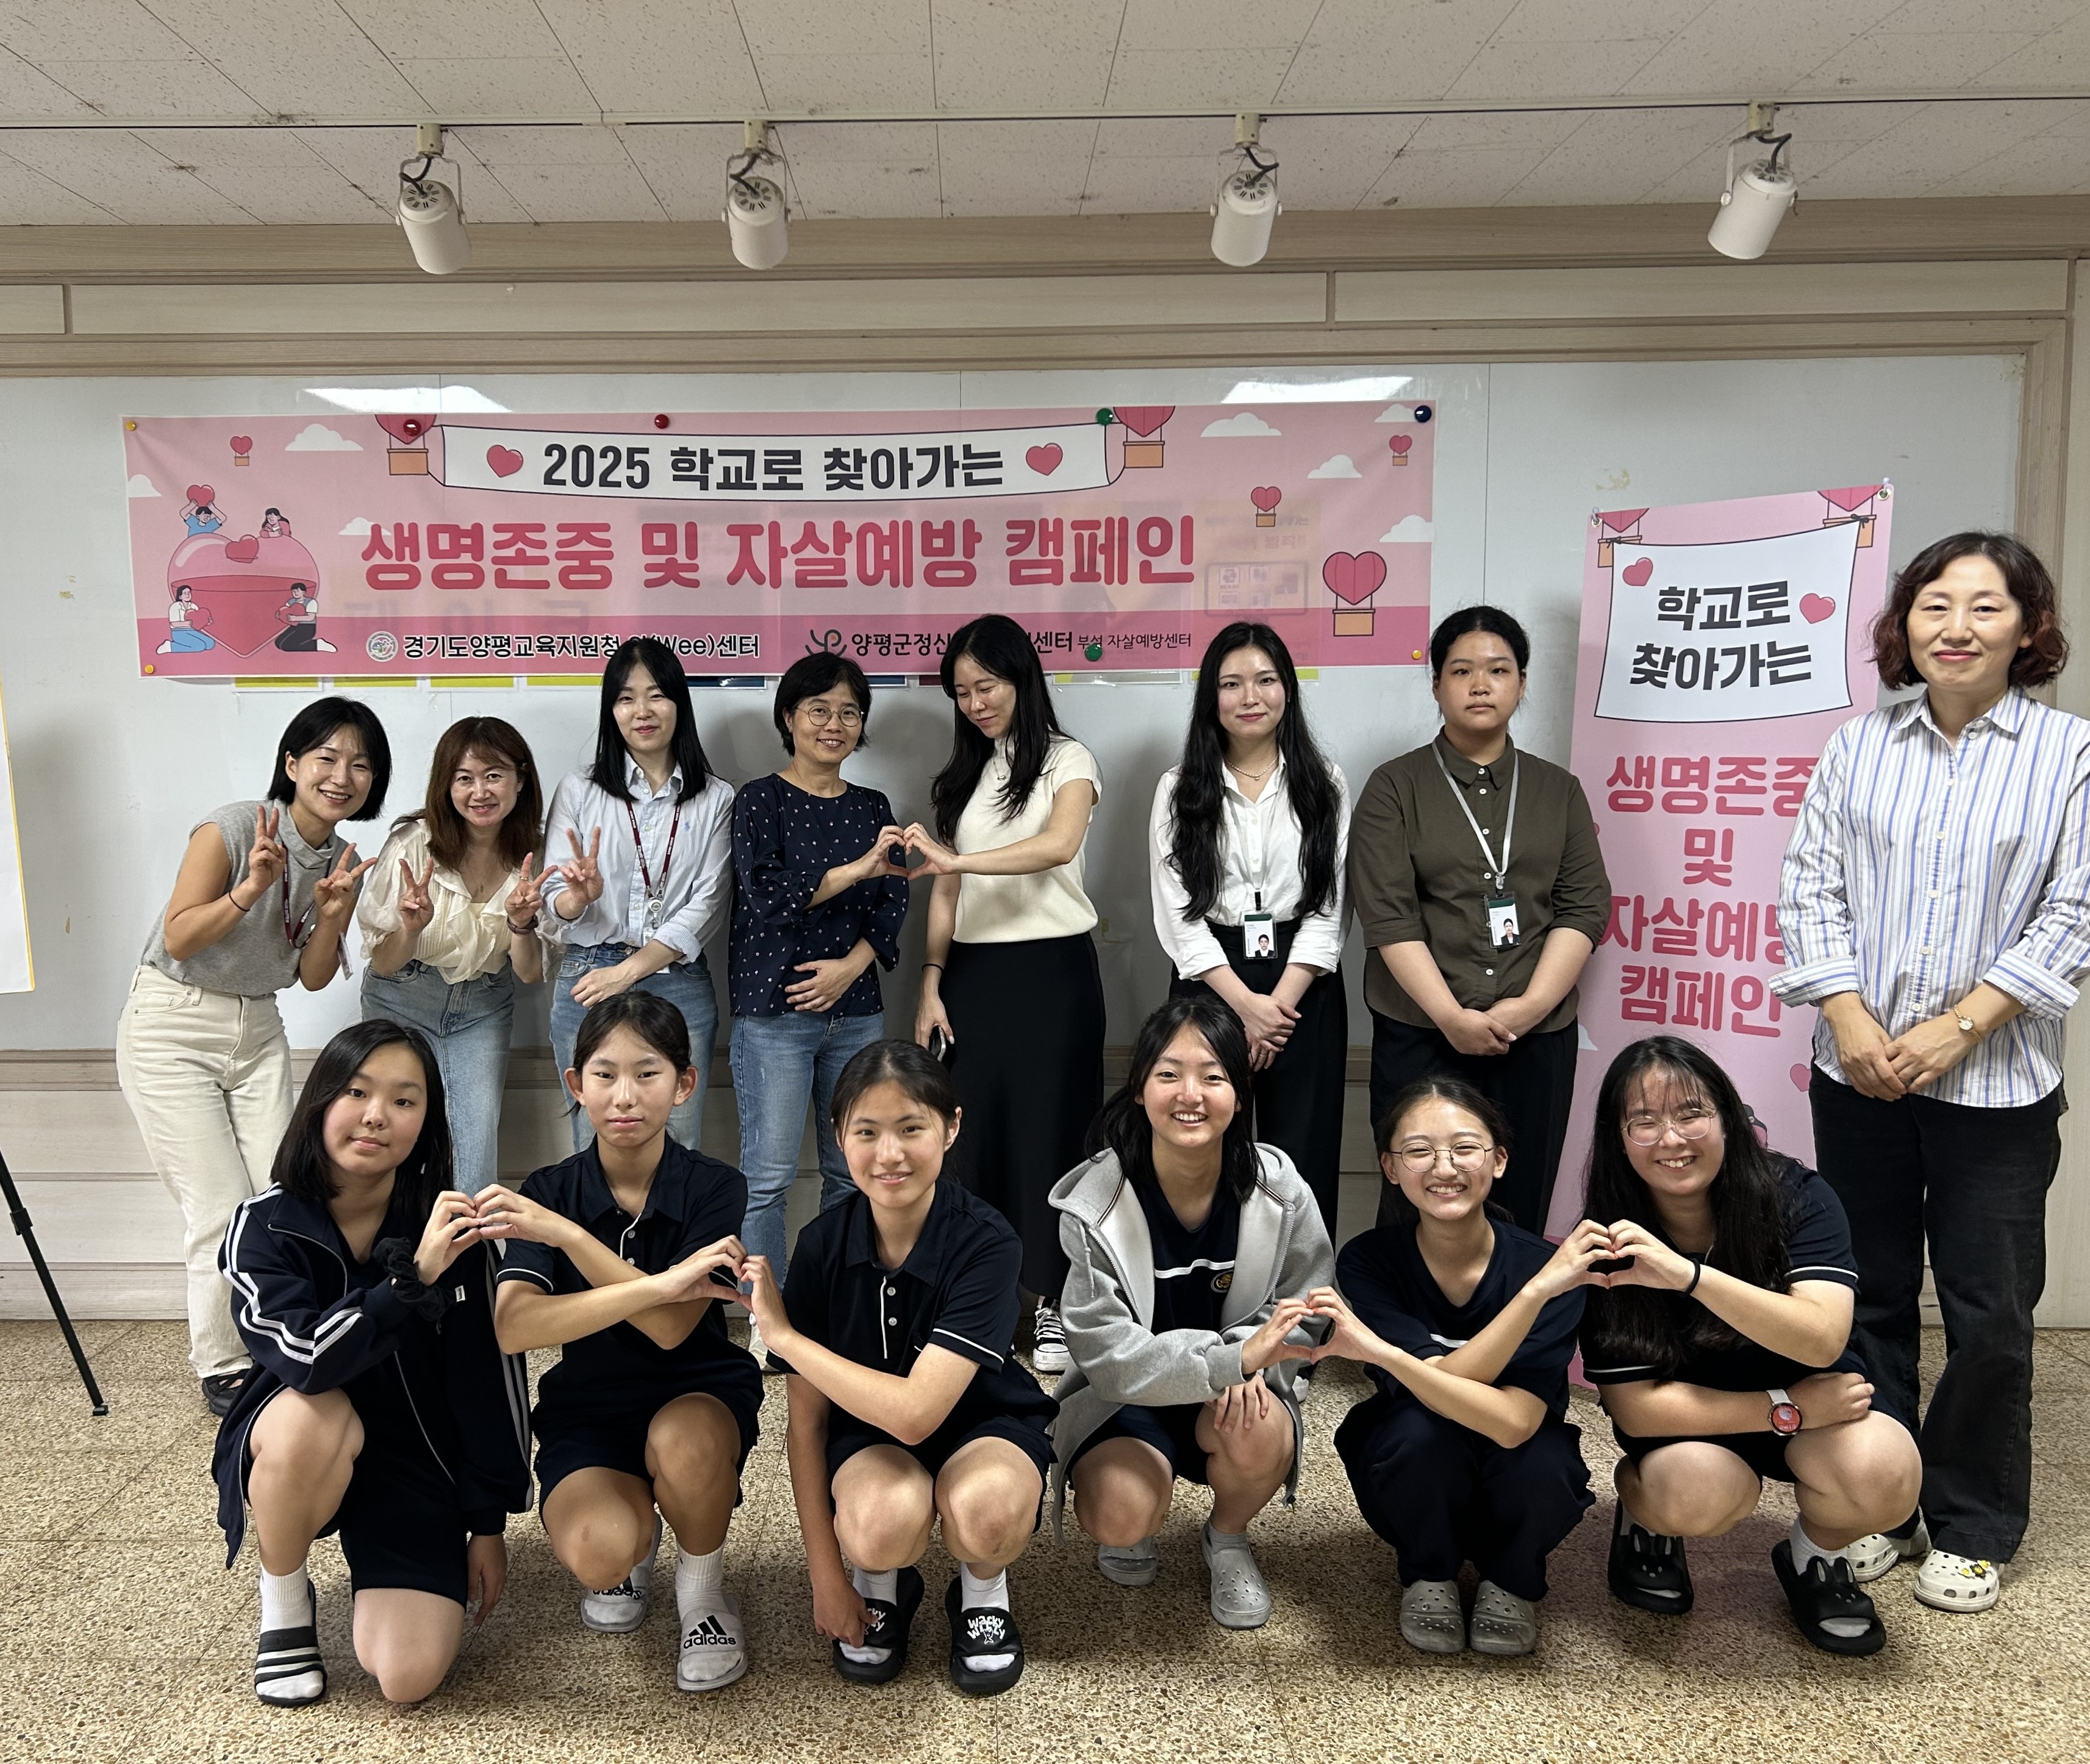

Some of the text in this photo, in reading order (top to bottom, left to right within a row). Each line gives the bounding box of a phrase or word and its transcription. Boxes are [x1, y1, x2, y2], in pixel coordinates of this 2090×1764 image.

[543, 443, 1003, 491] 2025 학교로 찾아가는
[362, 522, 614, 590] 생명존중
[641, 522, 701, 589] 및
[726, 520, 982, 589] 자살예방
[1005, 516, 1194, 586] 캠페인
[1657, 580, 1791, 631] 학교로
[404, 634, 620, 658] 경기도양평교육지원청
[1107, 633, 1191, 650] 자살예방센터
[1630, 640, 1811, 690] 찾아가는
[1606, 756, 1817, 817] 생명존중
[1683, 828, 1734, 887] 및
[1619, 964, 1781, 1038] 캠페인
[683, 1634, 737, 1649] adidas
